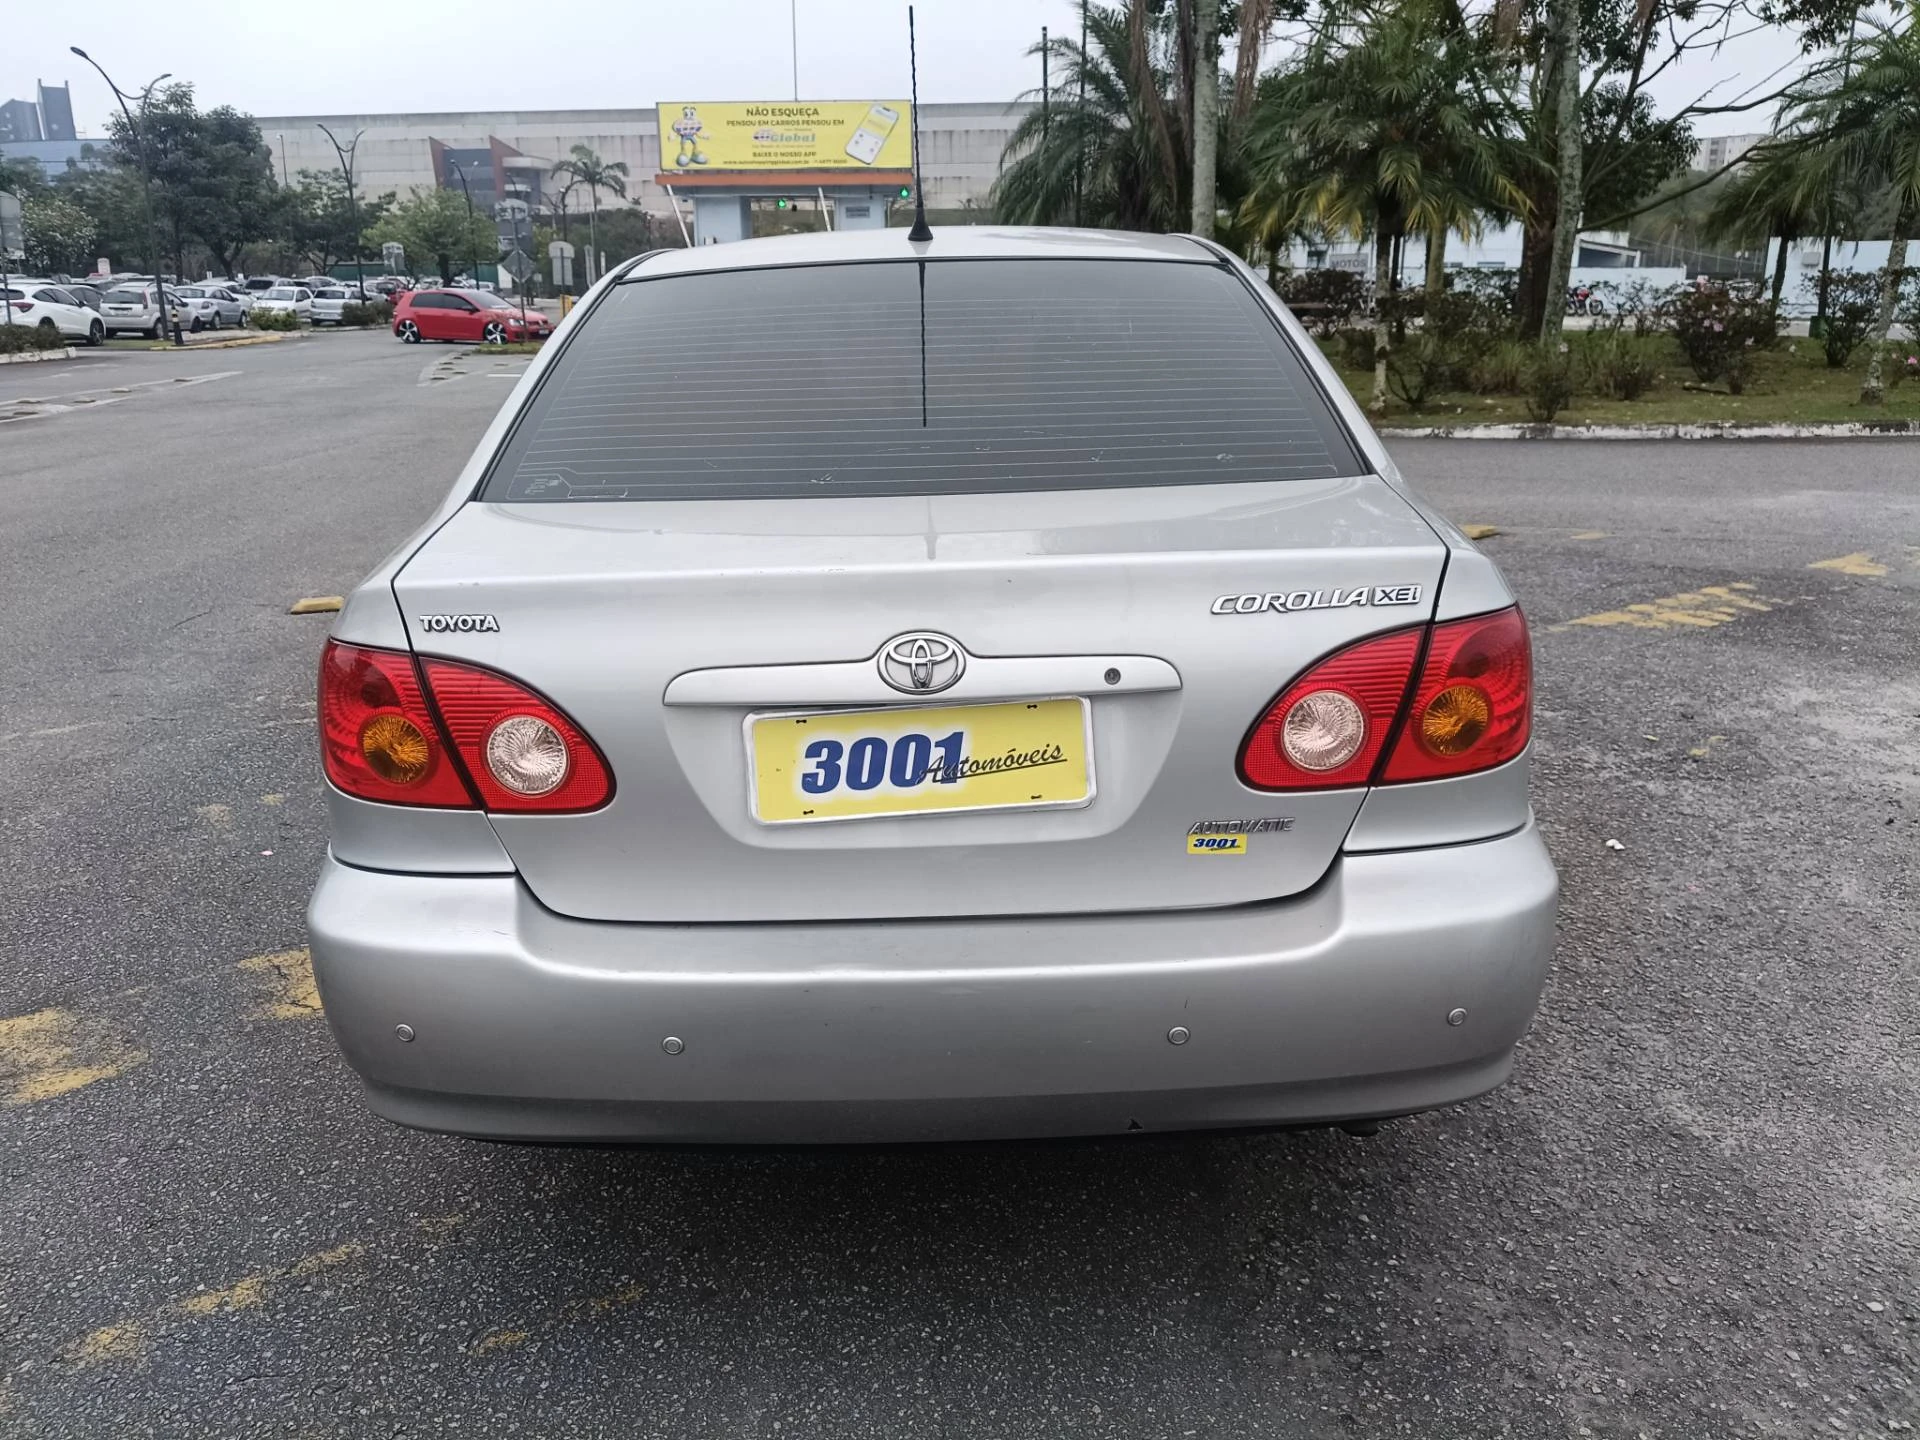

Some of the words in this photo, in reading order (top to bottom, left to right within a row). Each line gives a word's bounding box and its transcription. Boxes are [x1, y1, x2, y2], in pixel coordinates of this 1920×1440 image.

[746, 106, 769, 116] NÃO
[771, 107, 820, 118] ESQUEÇA
[1331, 259, 1368, 268] MOTOS
[1211, 585, 1371, 614] COROLLA
[419, 615, 500, 632] TOYOTA
[801, 731, 964, 794] 3001
[918, 743, 1064, 784] Automóveis
[1188, 817, 1295, 835] AUTOMATIC
[1193, 838, 1238, 848] 3001
